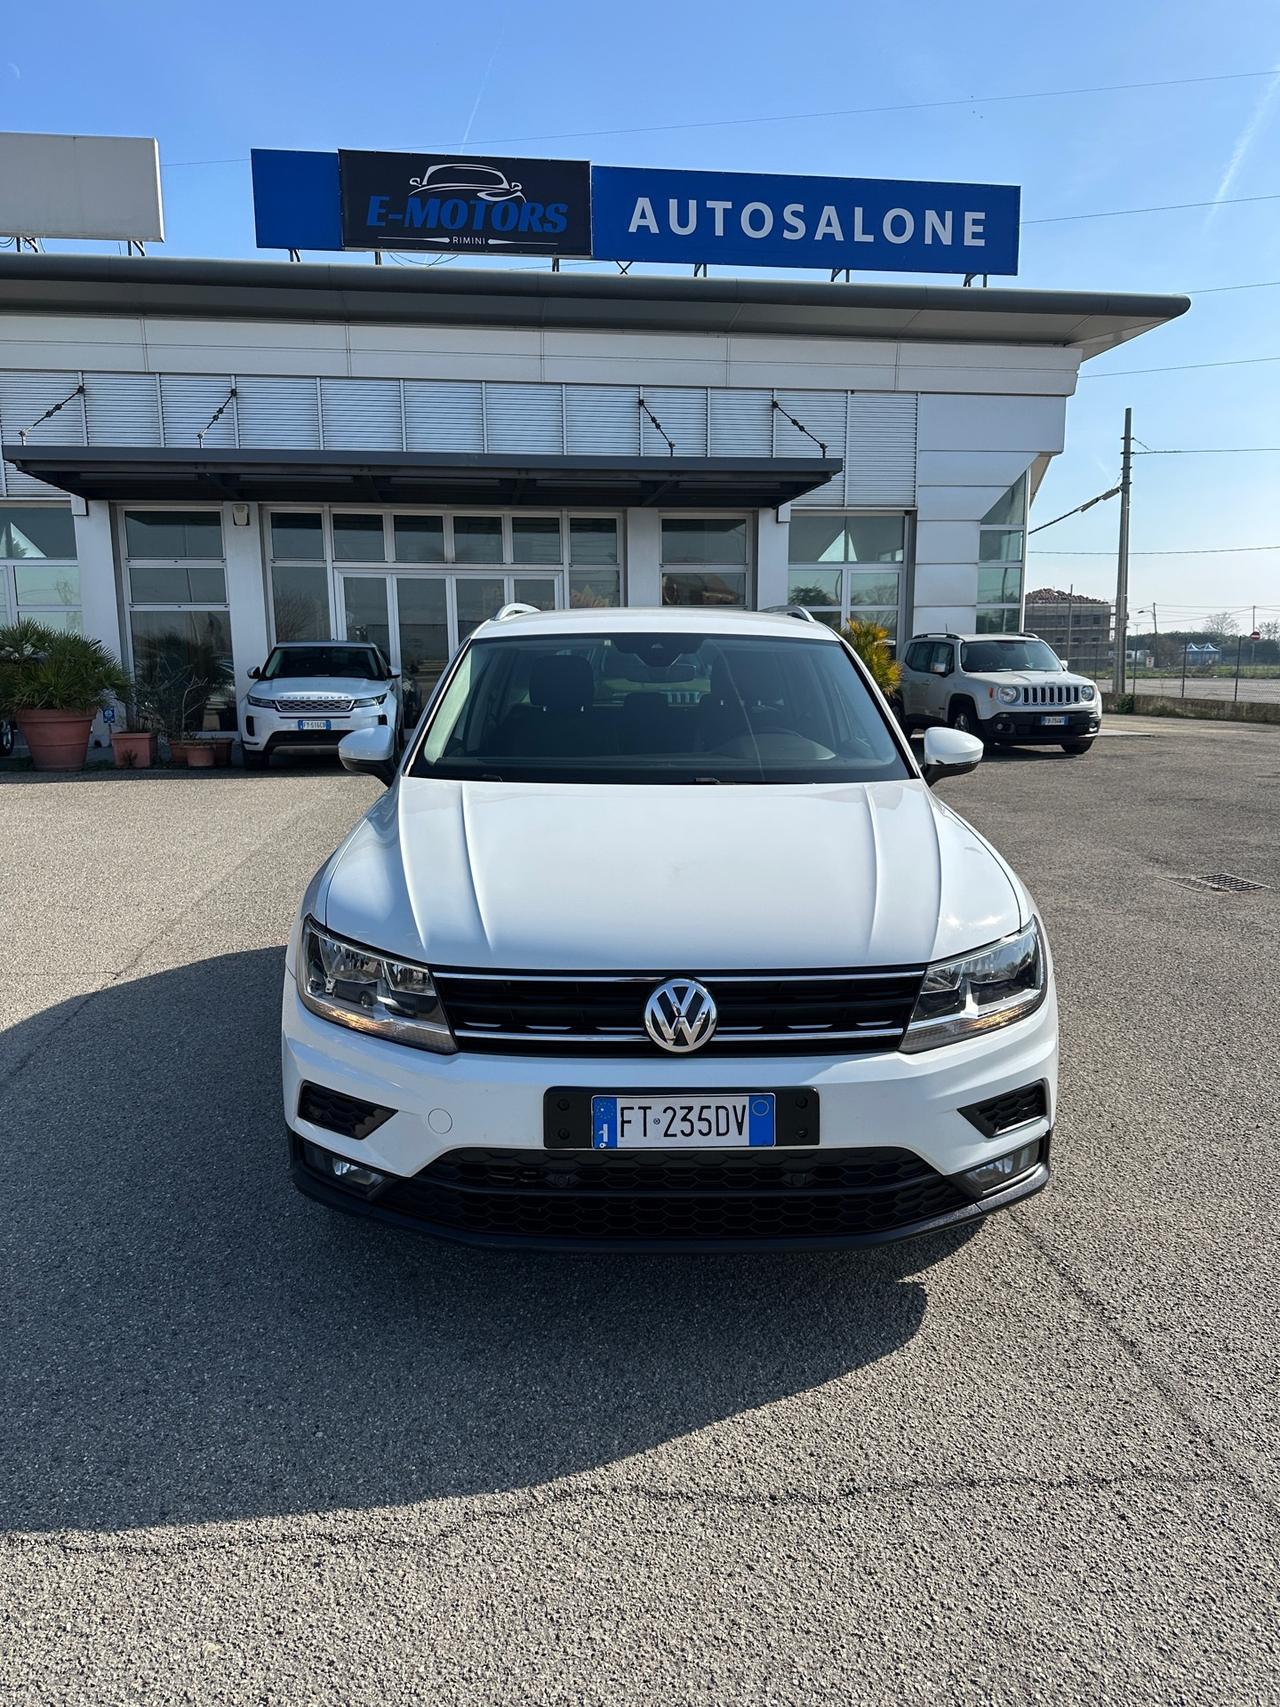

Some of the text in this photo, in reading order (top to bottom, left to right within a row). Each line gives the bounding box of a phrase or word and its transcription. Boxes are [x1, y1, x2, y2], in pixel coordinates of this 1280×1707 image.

[367, 195, 568, 234] E-MOTORS
[628, 196, 987, 247] AUTOSALONE
[452, 235, 487, 246] RIMINI
